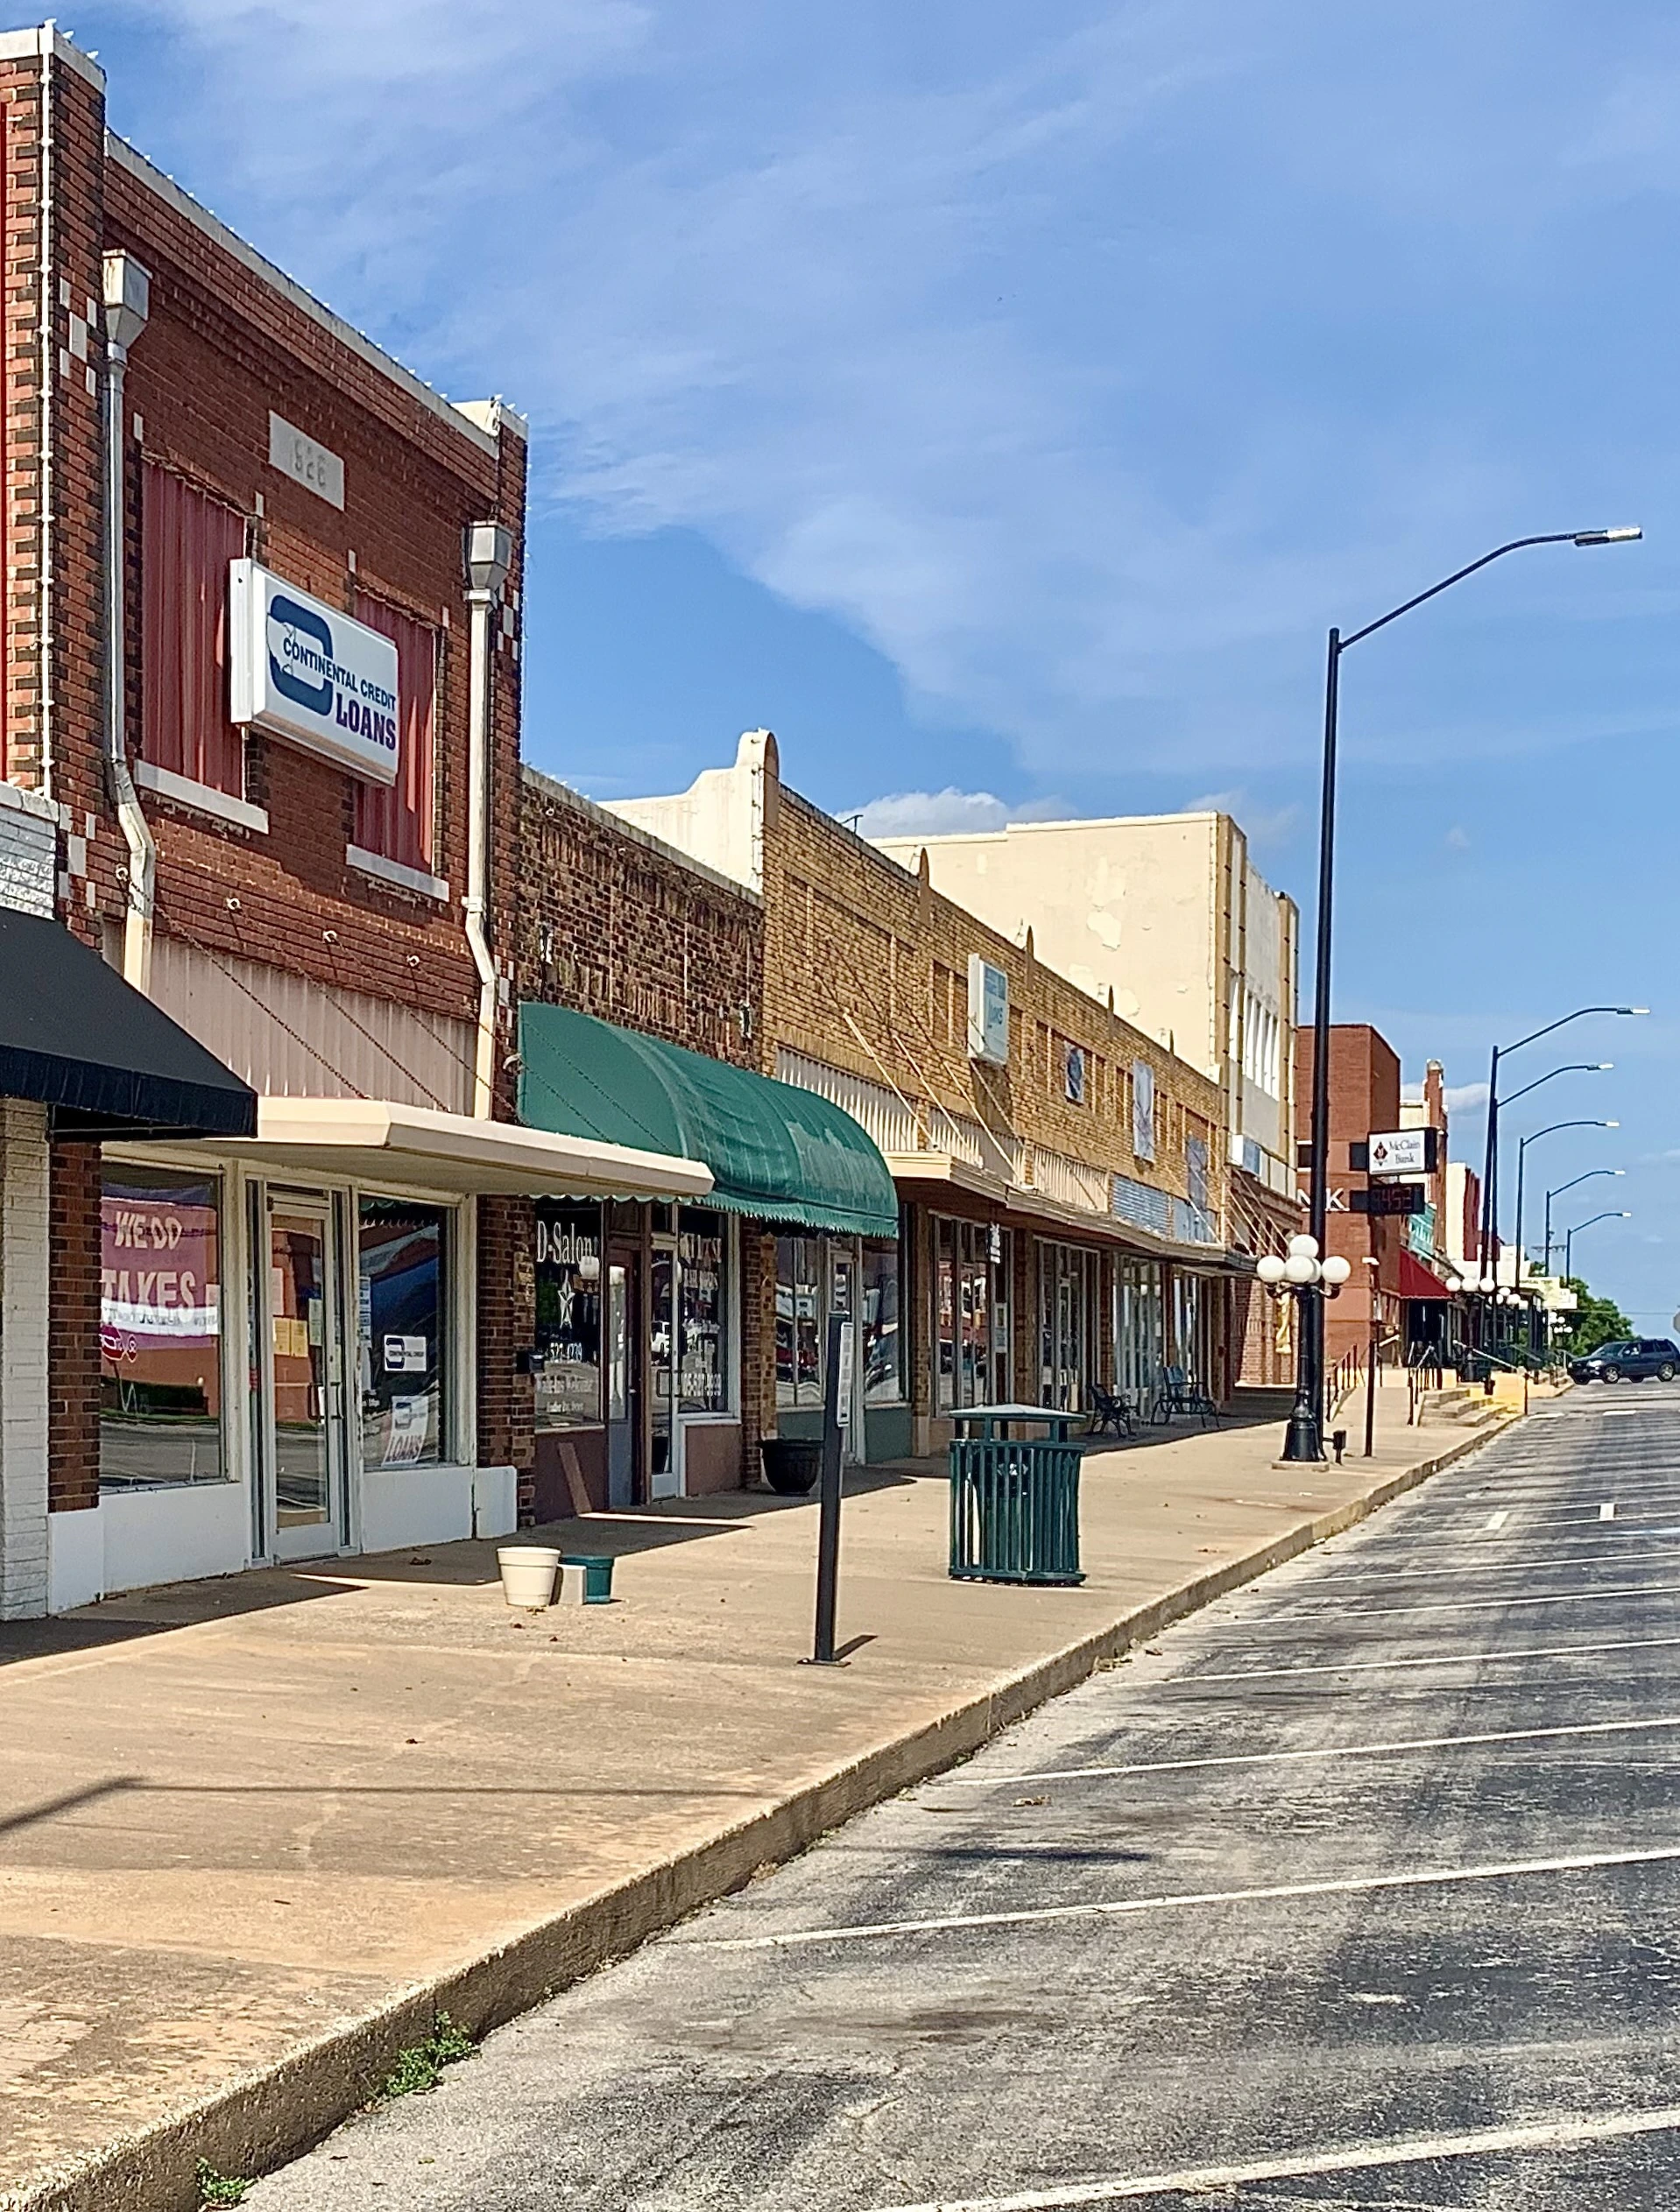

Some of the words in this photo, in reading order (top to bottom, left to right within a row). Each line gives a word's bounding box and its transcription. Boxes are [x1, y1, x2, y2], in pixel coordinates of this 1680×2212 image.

[283, 638, 357, 693] CONTINENTAL
[360, 679, 396, 711] CREDIT
[336, 693, 396, 750] LOANS
[1395, 1152, 1415, 1164] Bank
[115, 1212, 148, 1248] WE
[536, 1220, 593, 1265] D-Salon
